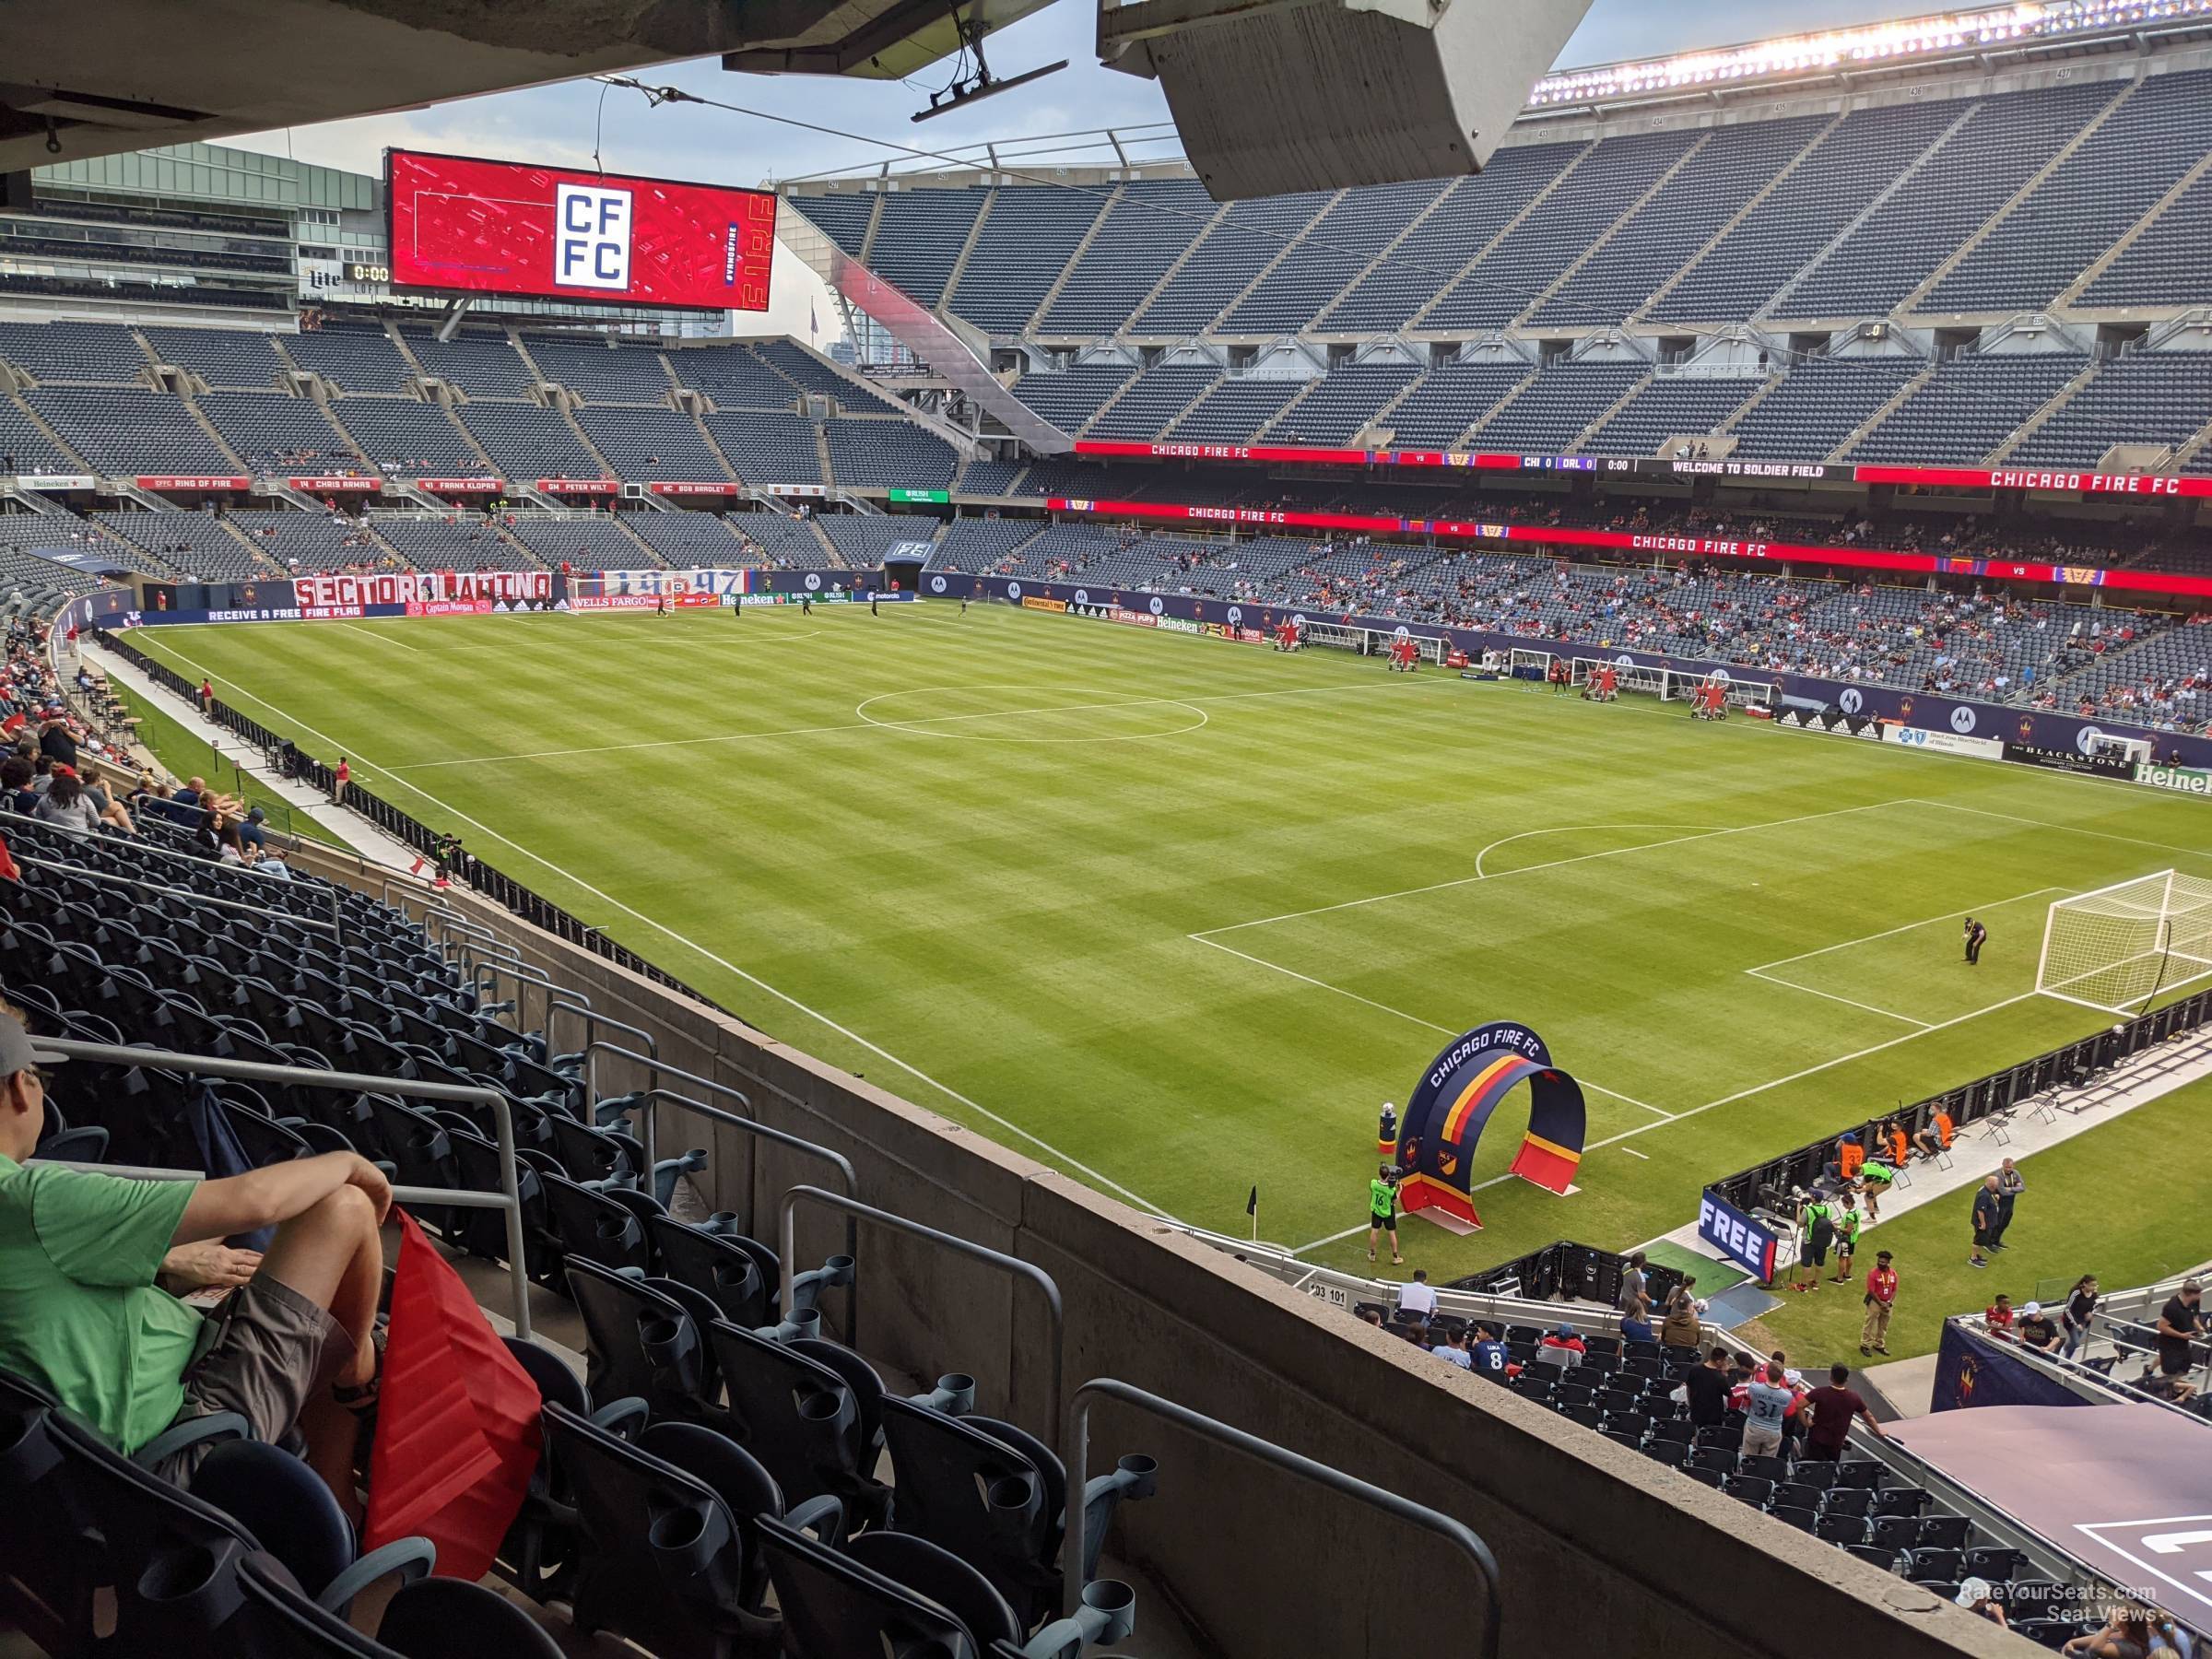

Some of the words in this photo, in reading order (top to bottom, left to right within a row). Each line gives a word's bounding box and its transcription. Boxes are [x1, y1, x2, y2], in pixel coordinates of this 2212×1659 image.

[566, 194, 623, 235] CF
[564, 239, 621, 279] FC
[310, 270, 341, 289] Lite
[355, 265, 389, 282] 0:00
[354, 283, 380, 295] LOFT
[1152, 444, 1198, 456] CHICAGO
[1205, 446, 1229, 457] FIRE
[1235, 447, 1249, 458] FC
[1524, 457, 1540, 467] CHI
[1545, 458, 1552, 468] 0
[1562, 458, 1581, 469] ORL
[1586, 459, 1593, 469] 0
[1607, 460, 1629, 471] 0:00
[1673, 461, 1724, 475] WELCOME
[1726, 463, 1741, 475] TO
[1743, 464, 1791, 477] SOLDIER
[1792, 465, 1824, 478] FIELD
[33, 478, 69, 488] Heineken
[174, 479, 195, 488] RING
[198, 479, 210, 488] OF
[212, 479, 231, 488] FIRE
[300, 480, 309, 488] 14
[316, 480, 340, 488] CHRIS
[343, 480, 371, 488] ARMAS
[467, 482, 497, 490] KLOPAS
[548, 483, 559, 491] GM
[565, 483, 588, 491] PETER
[694, 485, 725, 493] BRADLEY
[1991, 471, 2079, 489] CHICAGO
[2091, 475, 2139, 492] FIRE
[2152, 477, 2181, 494] FC
[1188, 507, 1235, 520] CHICAGO
[1241, 510, 1265, 522] FIRE
[1271, 512, 1285, 523] FC
[1632, 535, 1696, 551] CHICAGO
[1704, 540, 1738, 555] FIRE
[1747, 543, 1767, 557] FC
[2013, 566, 2025, 575] VS
[296, 574, 417, 606] SECTOR
[437, 572, 552, 602] LATINO
[572, 596, 609, 607] WELLS
[611, 596, 647, 607] FARGO
[722, 593, 774, 606] Heneken
[1024, 596, 1050, 608] Continental
[208, 610, 260, 621] RECEIVE
[262, 610, 270, 619] A
[273, 608, 301, 619] FREE
[305, 607, 330, 618] FIRE
[335, 606, 360, 617] FLAG
[426, 601, 449, 614] Captain
[450, 602, 474, 614] Morgan
[1119, 611, 1136, 621] PIZZA
[1137, 614, 1156, 624] PUFF
[1157, 615, 1198, 634] Heineken
[1780, 719, 1801, 727] adidas
[1806, 723, 1827, 731] adidas
[1830, 726, 1853, 735] adidas
[1857, 731, 1879, 739] adidas
[1930, 732, 1957, 741] BlueCross
[1958, 736, 1987, 746] BlueShield
[2026, 746, 2127, 769] BLACKSTONE
[1430, 1032, 1489, 1088] CHICAGO
[1493, 1029, 1524, 1046] FIRE
[1523, 1037, 1540, 1057] FC
[1375, 1194, 1384, 1206] 16
[1699, 1198, 1762, 1266] FREE
[1330, 1289, 1345, 1303] 101
[1490, 1352, 1503, 1371] 8
[1754, 1400, 1780, 1418] 31
